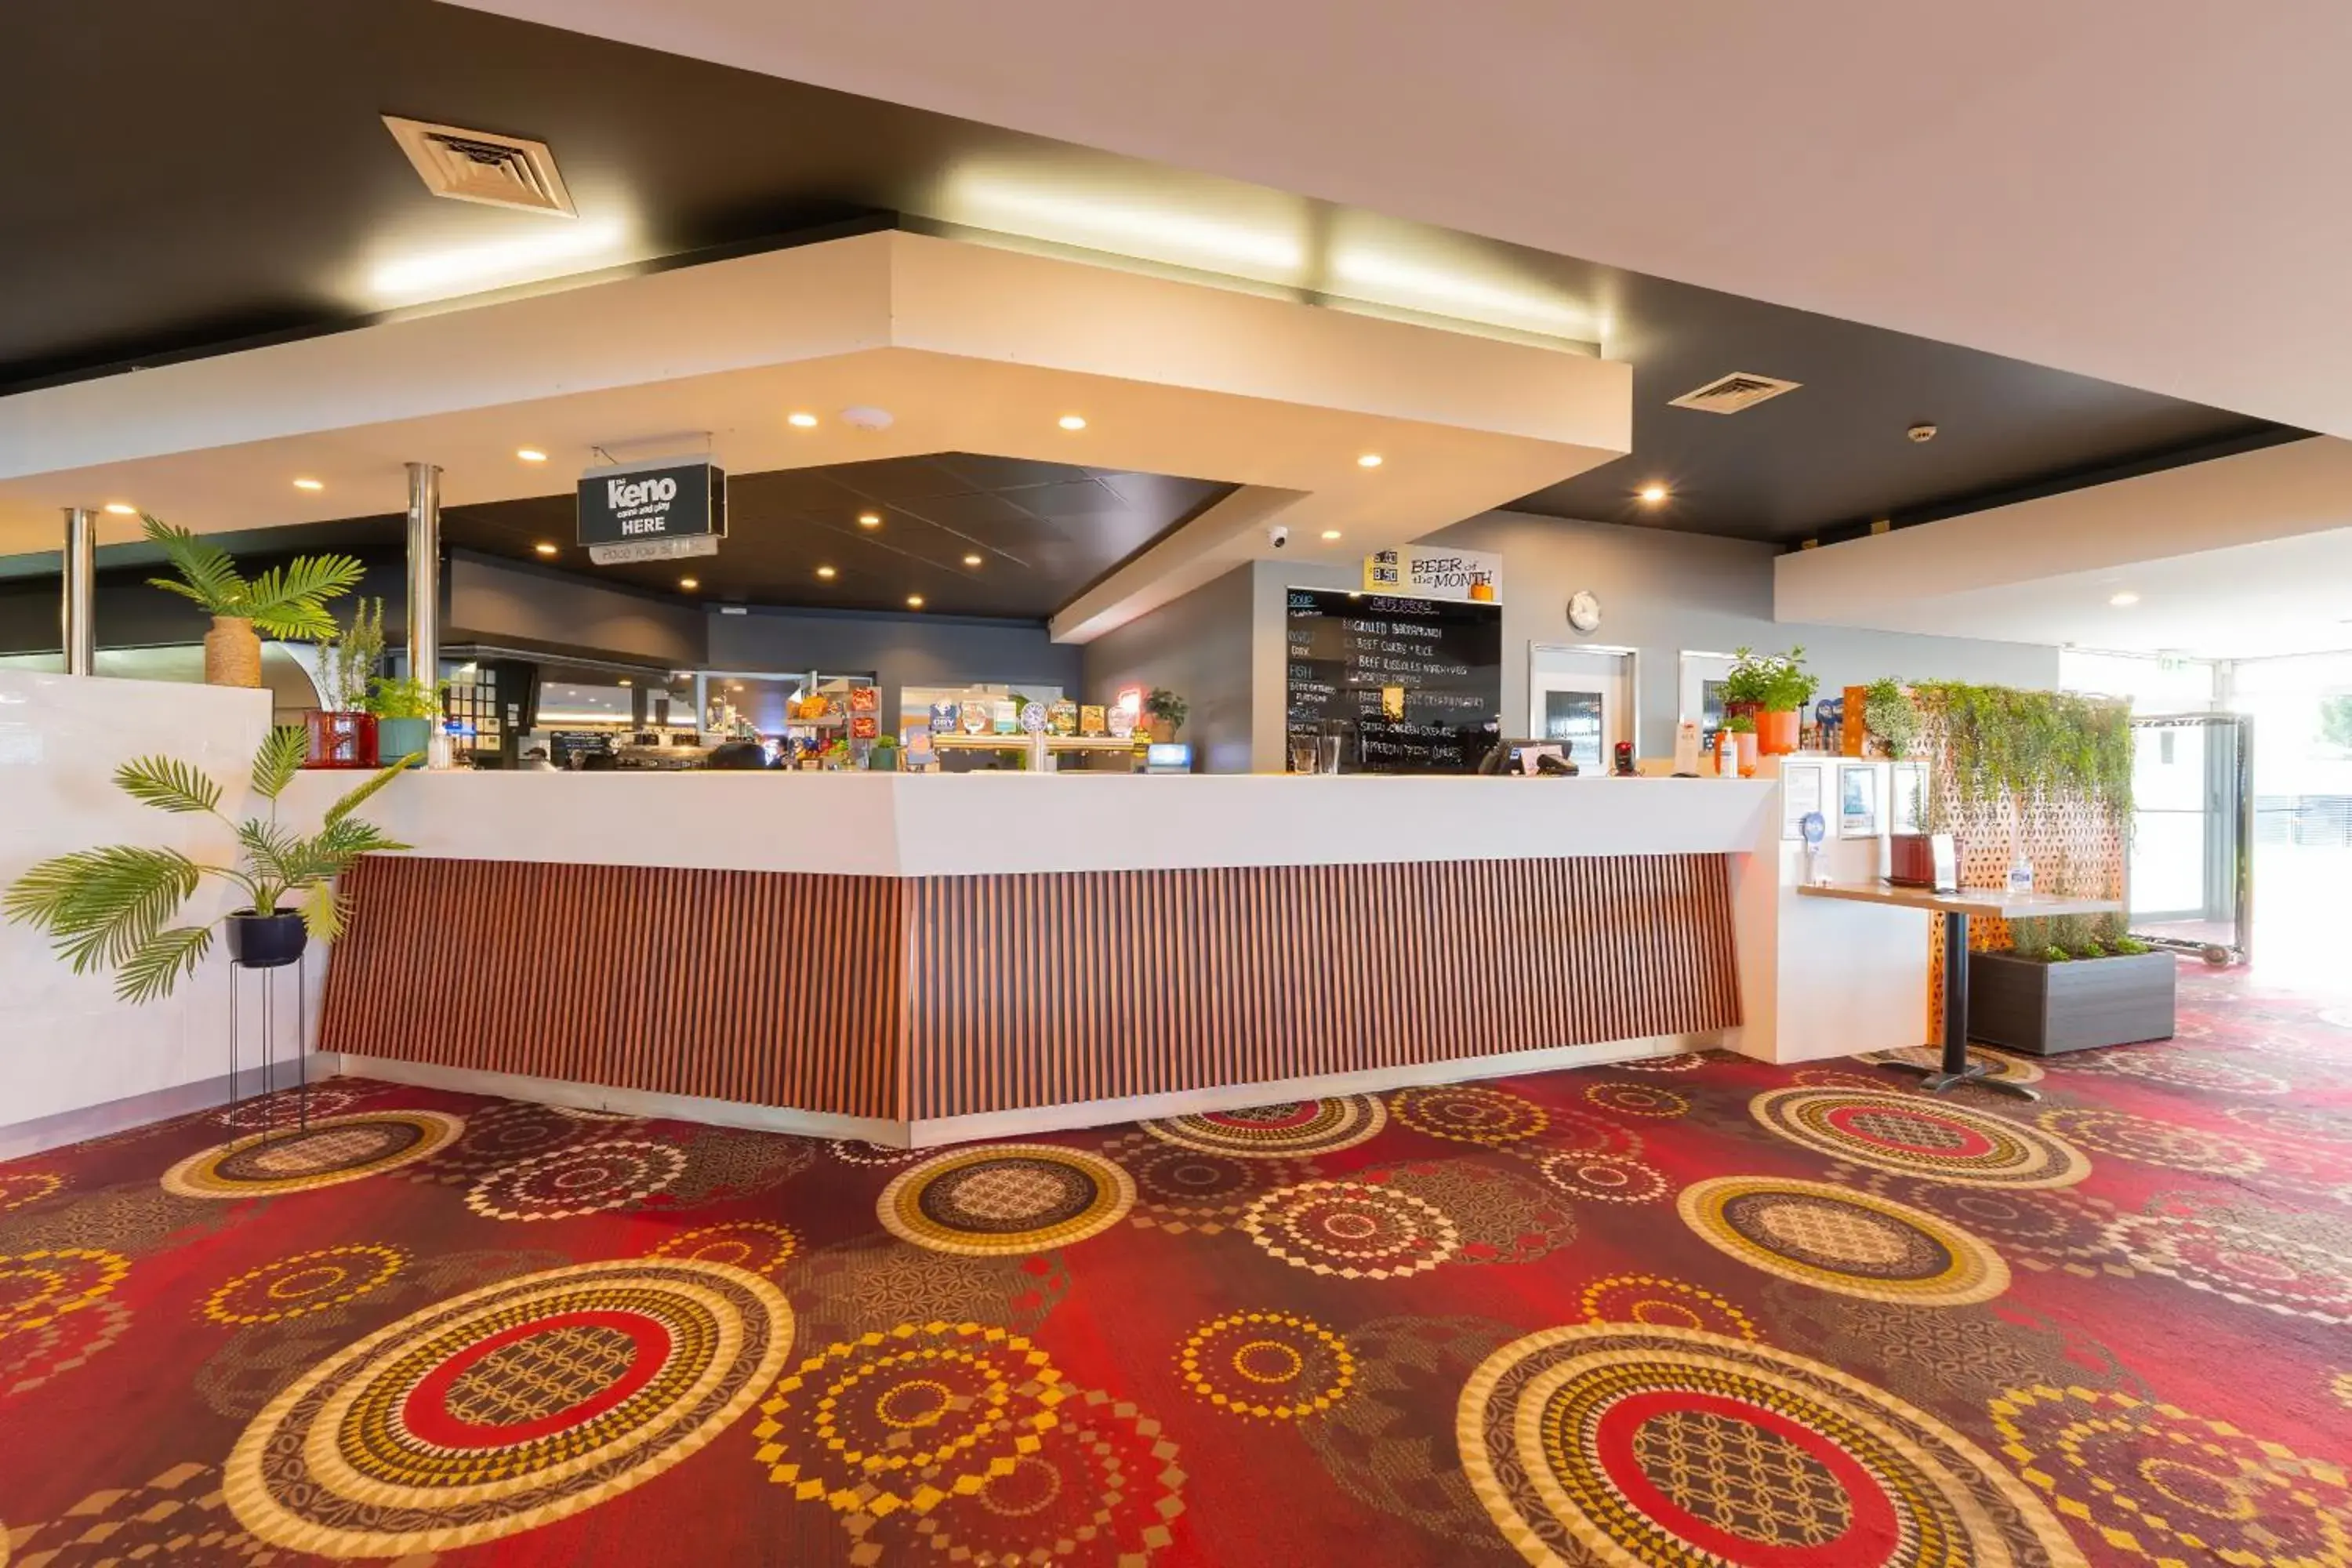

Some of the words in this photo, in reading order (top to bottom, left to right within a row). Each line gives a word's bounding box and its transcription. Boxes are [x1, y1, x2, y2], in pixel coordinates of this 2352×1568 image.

[608, 477, 677, 509] keno
[617, 509, 637, 518] come
[639, 503, 653, 515] and
[654, 501, 670, 514] play
[622, 517, 666, 535] HERE
[1412, 557, 1462, 574] BEER
[1414, 575, 1432, 584] the
[1434, 570, 1493, 589] MONTH
[1290, 593, 1313, 604] SOUP
[1359, 655, 1381, 667] BEEF
